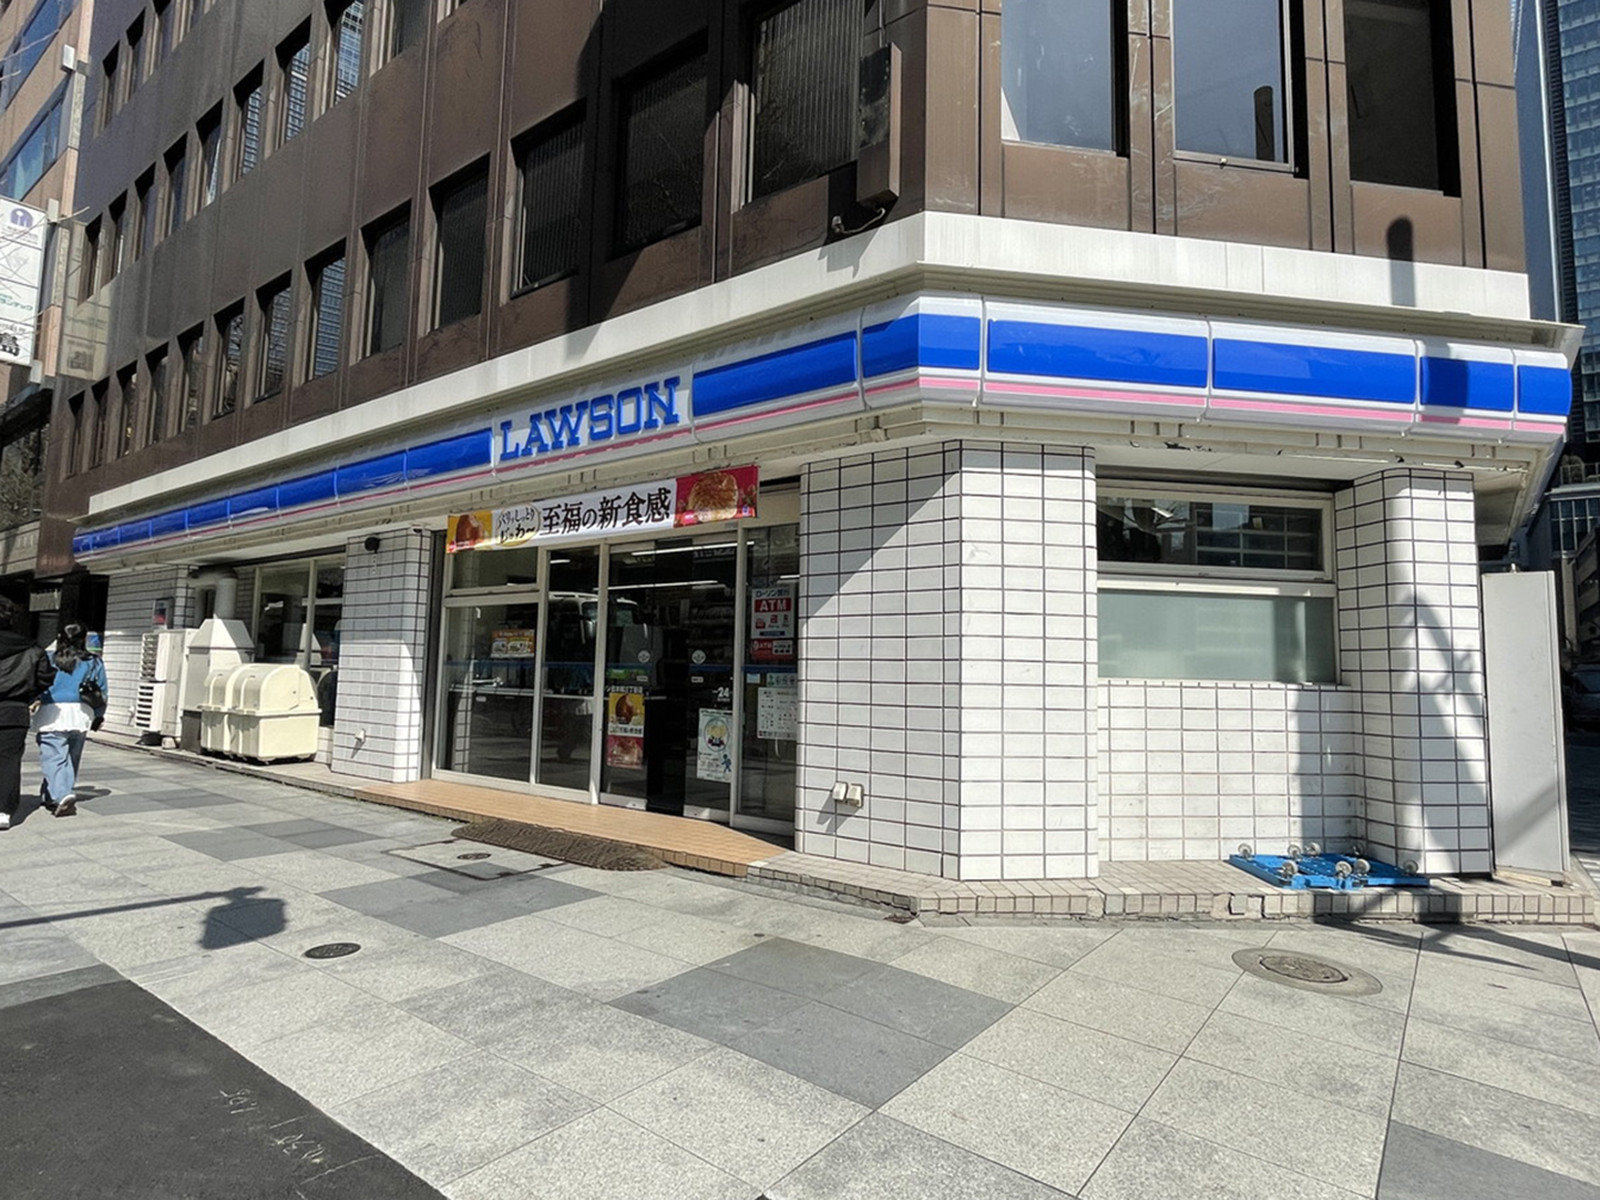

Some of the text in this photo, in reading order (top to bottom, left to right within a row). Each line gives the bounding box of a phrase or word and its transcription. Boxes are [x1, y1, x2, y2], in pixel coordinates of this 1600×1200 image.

[500, 376, 680, 461] LAWSON
[540, 487, 672, 536] 至福の新食感
[760, 599, 786, 612] ATM
[717, 686, 730, 698] 24
